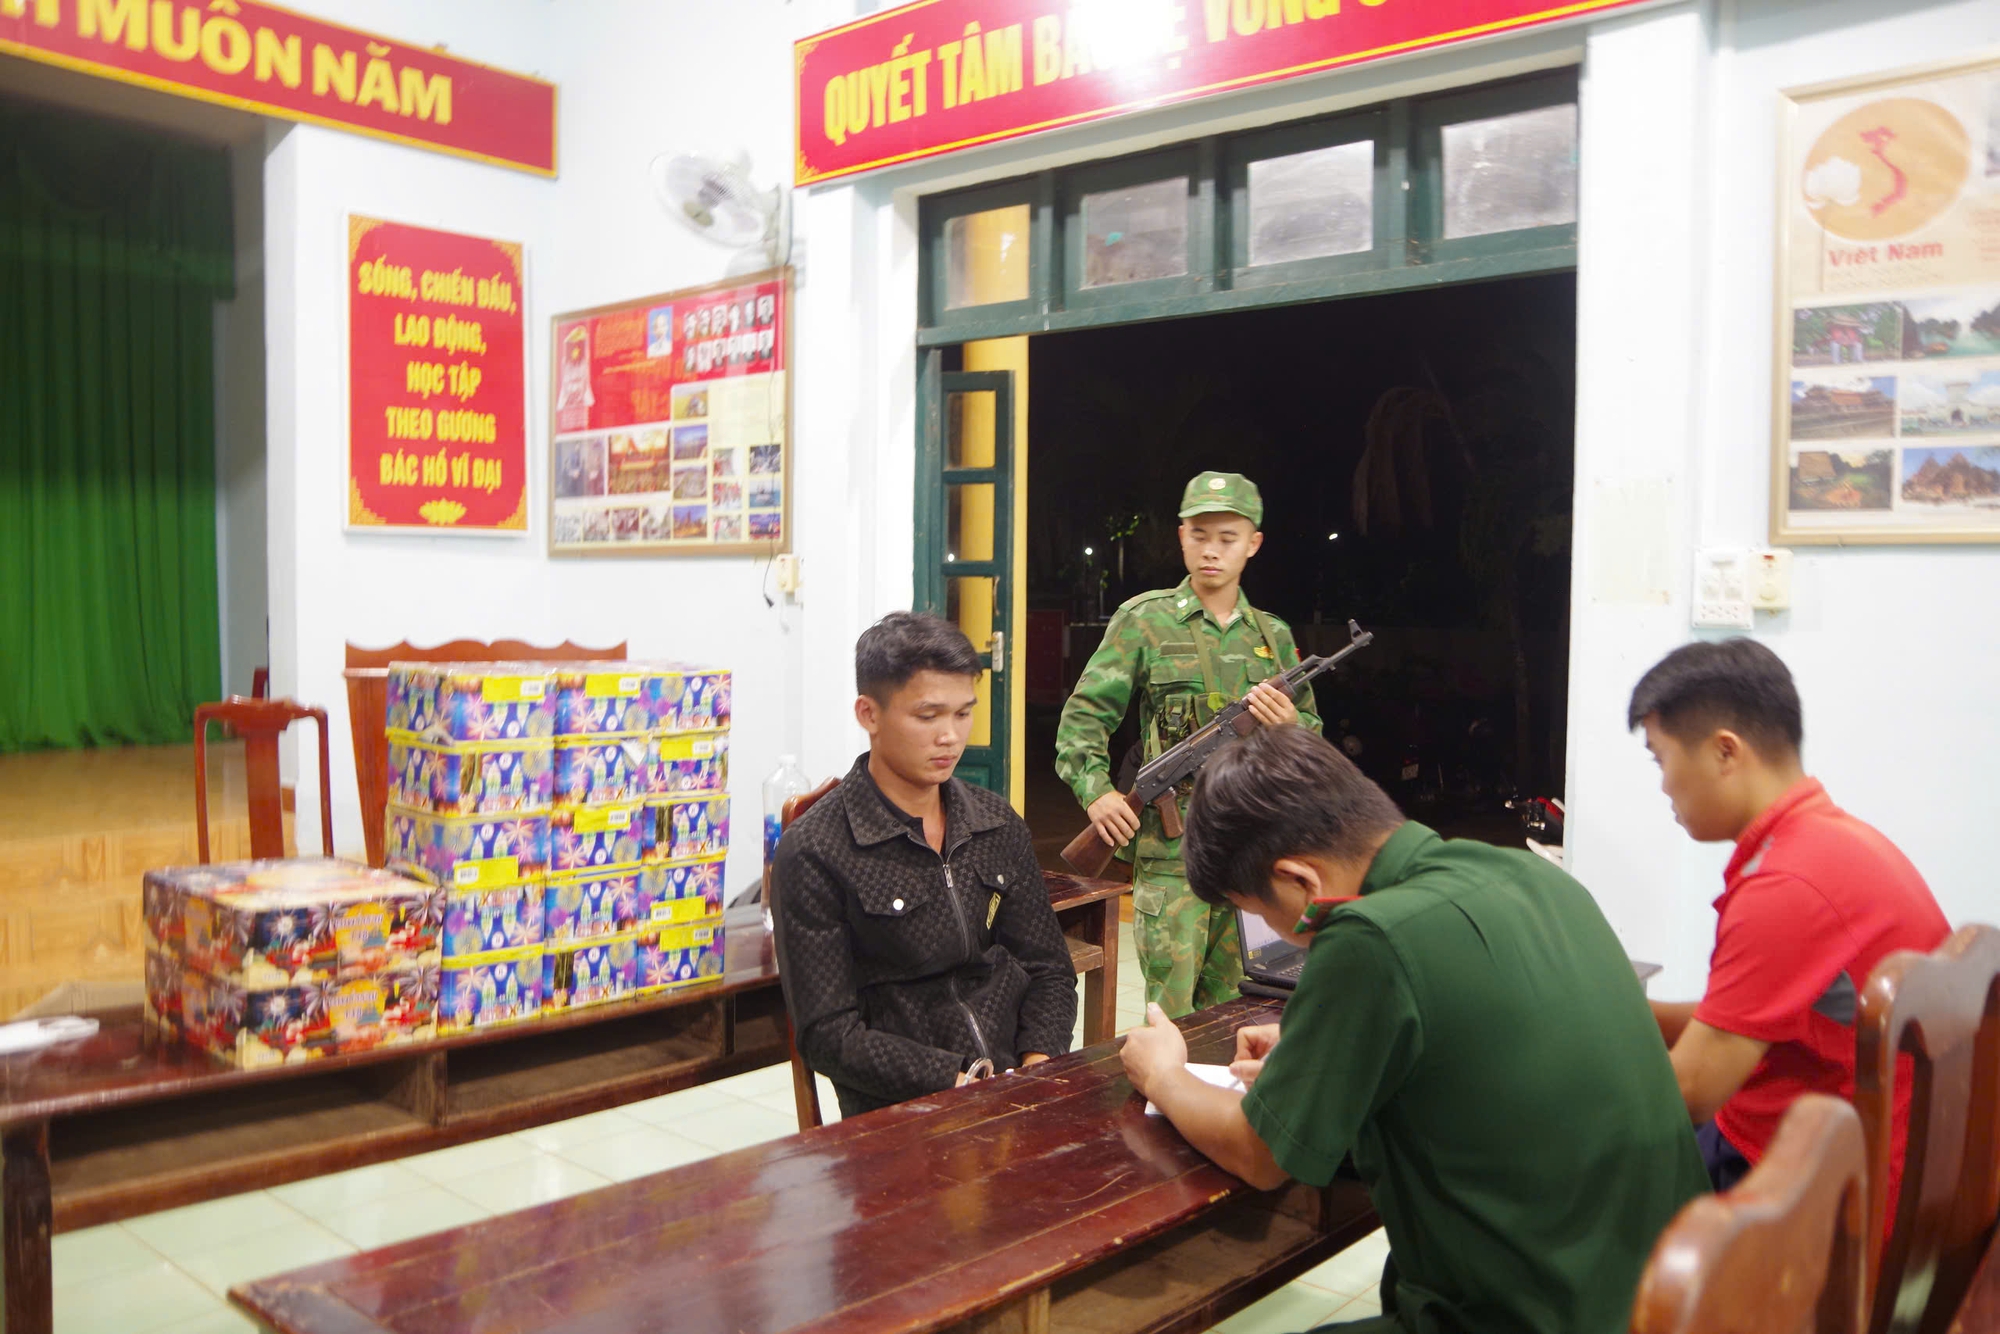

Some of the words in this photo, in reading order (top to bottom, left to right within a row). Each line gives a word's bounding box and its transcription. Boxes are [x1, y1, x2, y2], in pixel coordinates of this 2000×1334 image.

[312, 41, 453, 126] NĂM
[824, 32, 932, 147] QUYẾT
[937, 20, 1023, 110] TÂM
[1887, 241, 1944, 261] Nam
[358, 253, 418, 303] SỐNG,
[420, 266, 475, 307] CHIẾN
[394, 312, 431, 346] LAO
[406, 360, 446, 400] HỌC
[447, 359, 482, 403] TẬP
[385, 405, 433, 441] THEO
[380, 447, 419, 487] BÁC
[472, 456, 503, 495] ĐẠI
